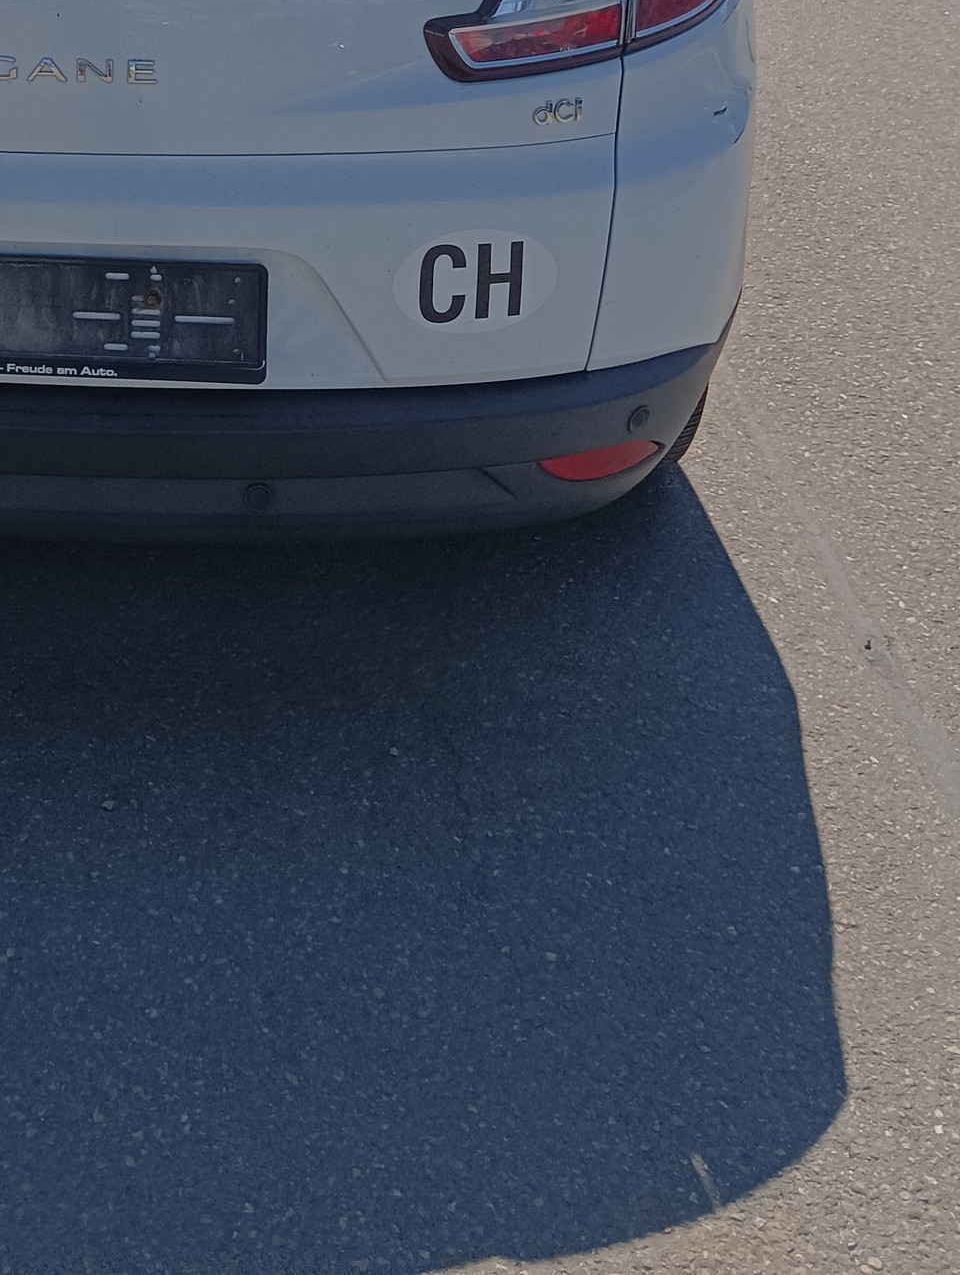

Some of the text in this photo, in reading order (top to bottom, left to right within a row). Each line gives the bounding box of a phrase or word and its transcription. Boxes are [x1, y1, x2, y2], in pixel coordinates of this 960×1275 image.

[532, 97, 583, 126] dCi
[418, 240, 525, 324] CH
[6, 363, 53, 374] Freude
[56, 367, 77, 375] am
[80, 366, 118, 377] Auto.
